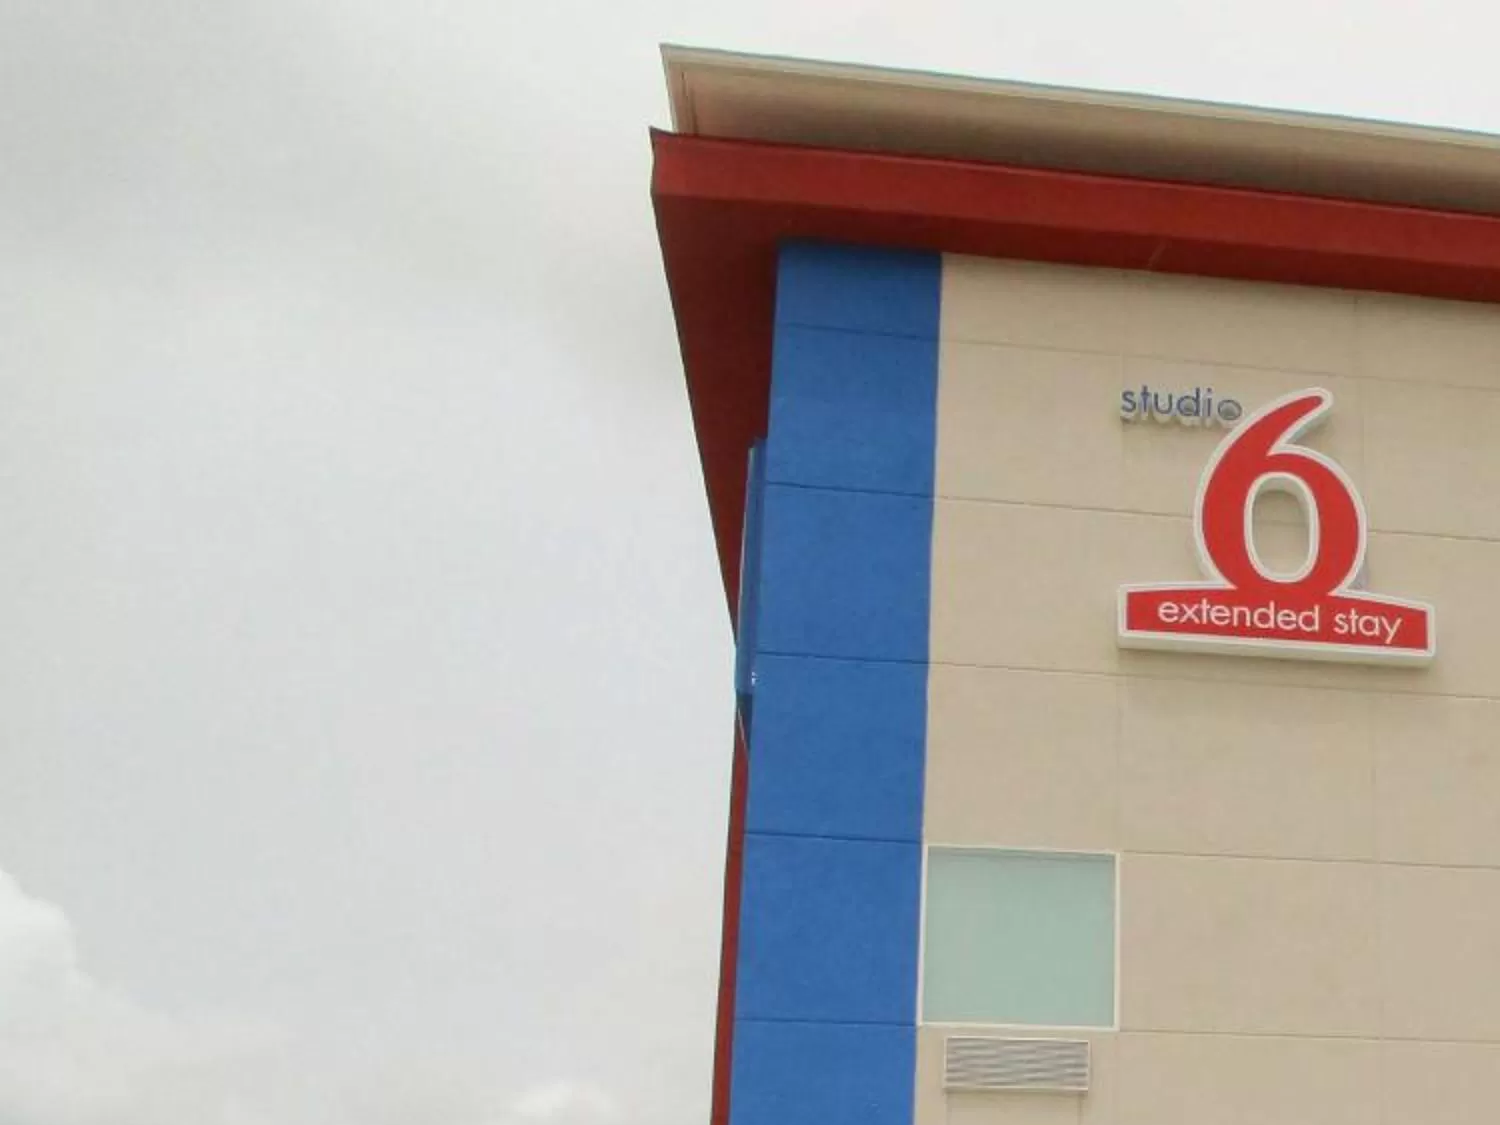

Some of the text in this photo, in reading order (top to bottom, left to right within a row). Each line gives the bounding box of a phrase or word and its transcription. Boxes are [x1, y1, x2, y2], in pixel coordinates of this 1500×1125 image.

[1121, 385, 1243, 421] studio
[1197, 390, 1363, 592] 6
[1157, 599, 1403, 645] extended stay
